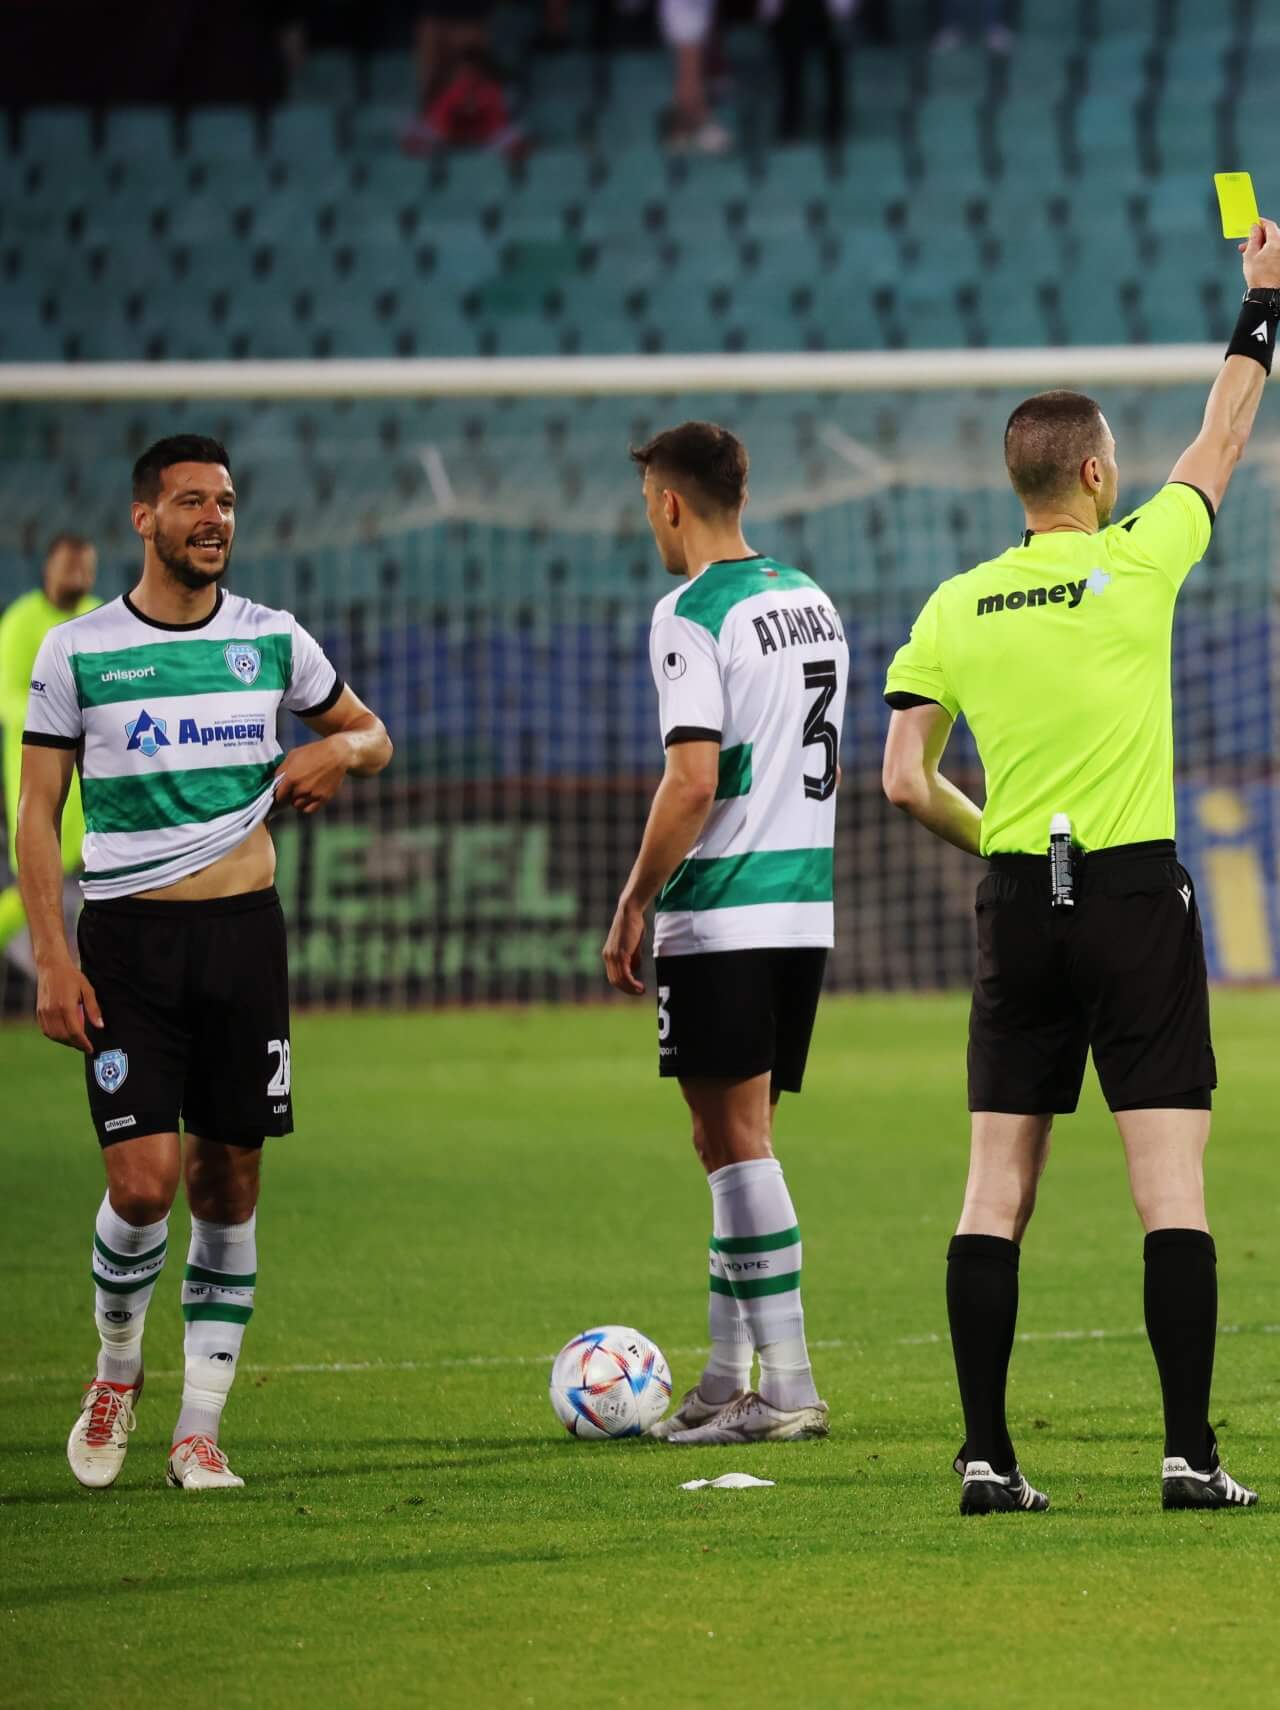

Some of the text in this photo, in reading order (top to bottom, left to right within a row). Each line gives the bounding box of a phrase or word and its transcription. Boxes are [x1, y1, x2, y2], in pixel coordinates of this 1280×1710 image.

[101, 666, 155, 682] uhlsport
[178, 718, 265, 746] Армеец
[802, 659, 838, 802] 3
[658, 986, 671, 1040] 3
